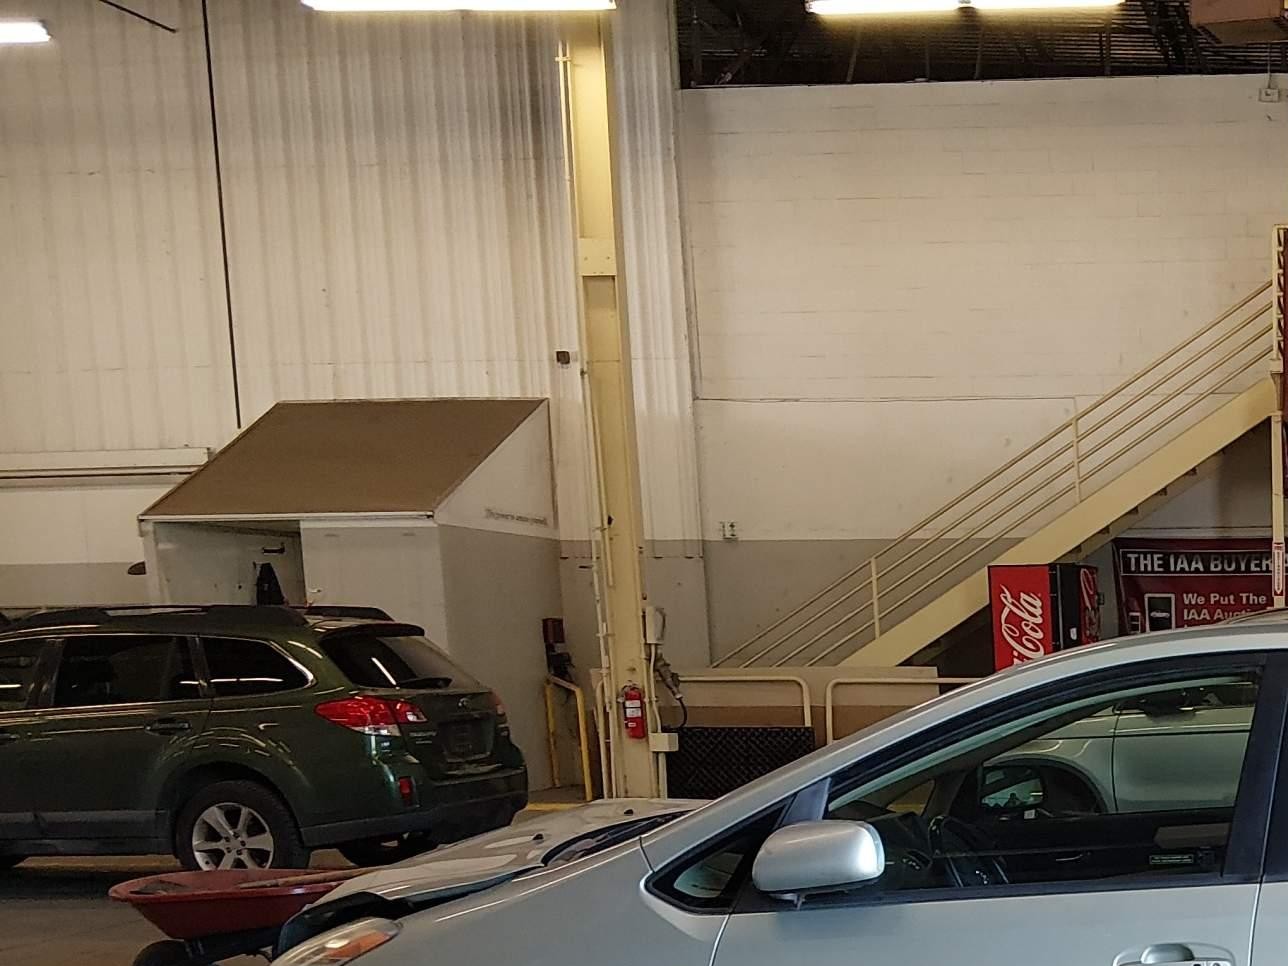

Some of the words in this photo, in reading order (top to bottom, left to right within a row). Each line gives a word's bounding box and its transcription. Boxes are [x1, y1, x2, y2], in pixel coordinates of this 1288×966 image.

[1127, 553, 1165, 572] THE
[1169, 553, 1204, 572] IAA
[1210, 552, 1273, 572] BUYER
[1183, 593, 1205, 605] We
[1210, 593, 1235, 605] Put
[1240, 593, 1267, 604] The
[1183, 608, 1211, 620] IAA
